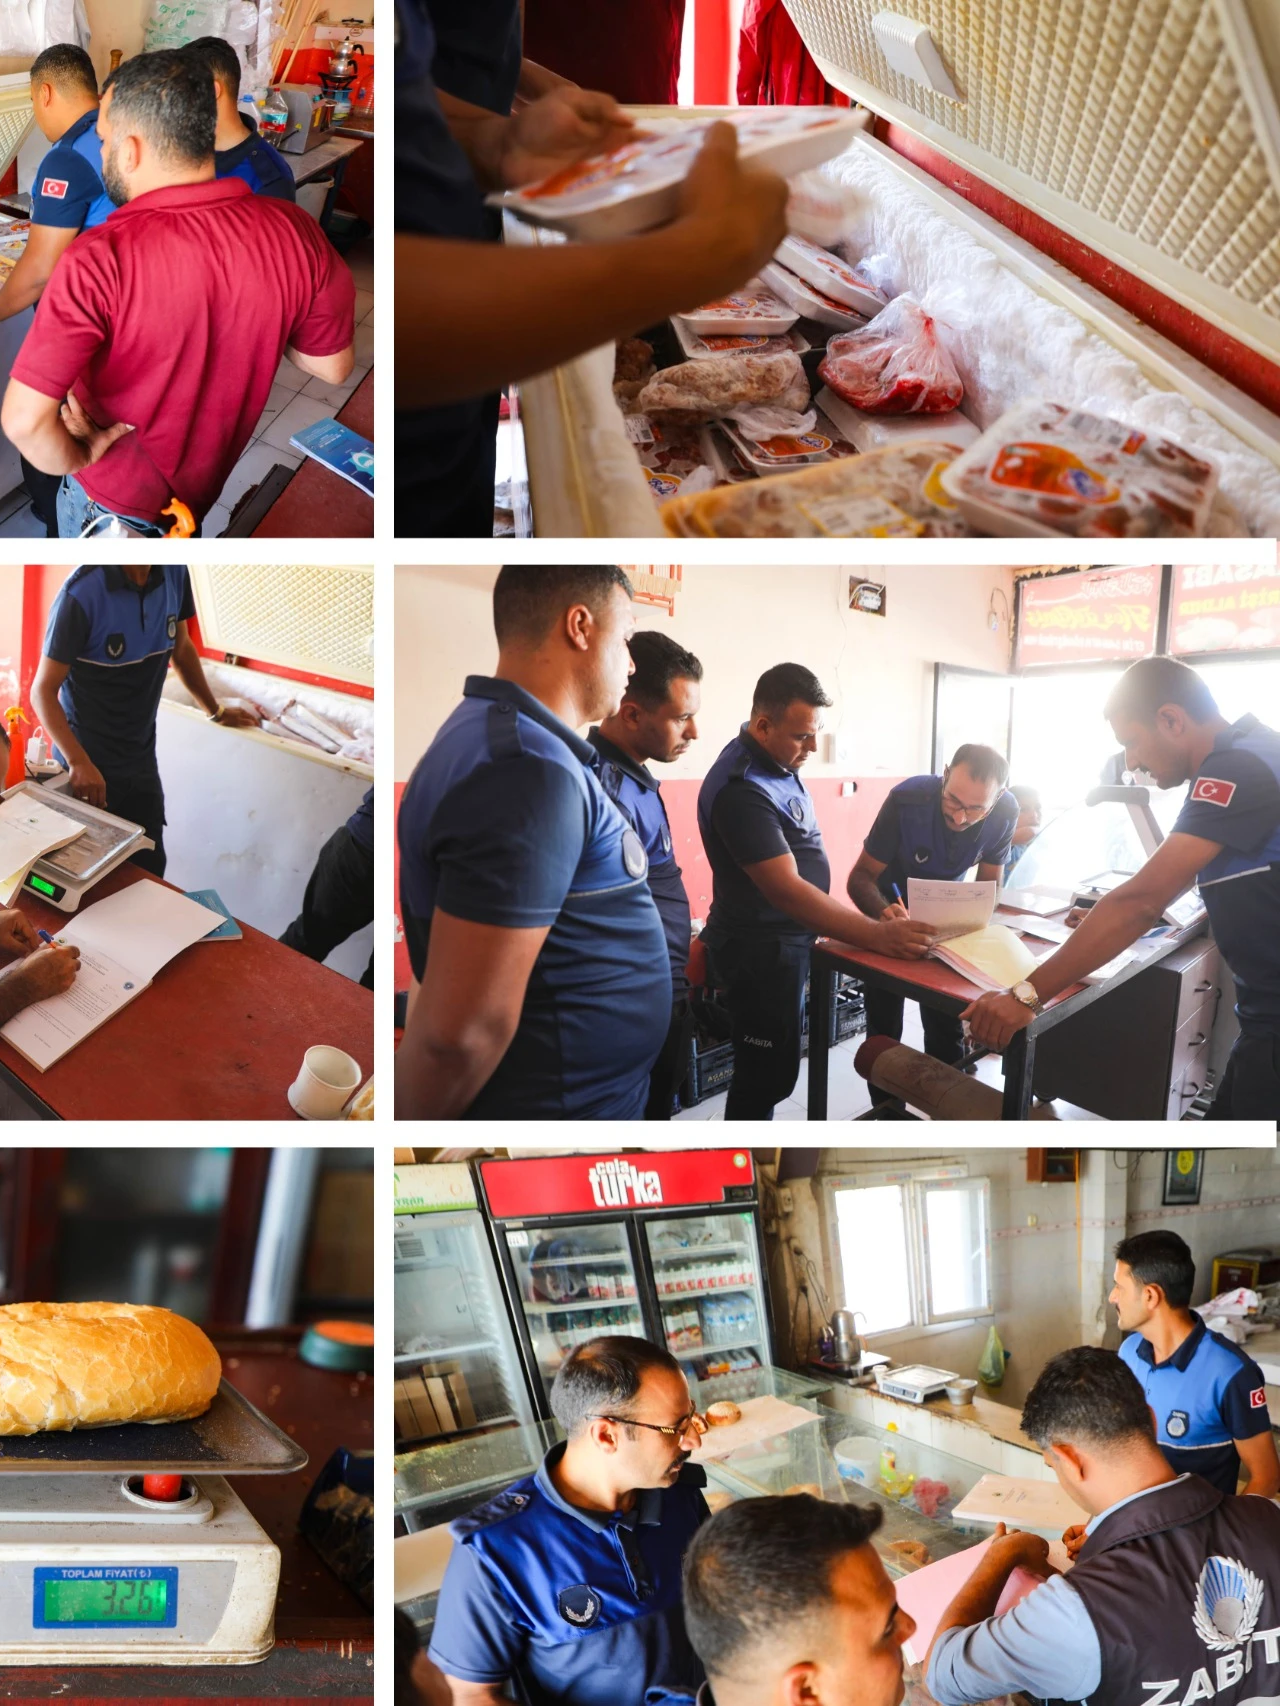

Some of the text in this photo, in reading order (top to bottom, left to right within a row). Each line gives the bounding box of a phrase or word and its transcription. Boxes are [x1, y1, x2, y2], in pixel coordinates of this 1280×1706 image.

[743, 1034, 773, 1048] ZABITA
[595, 1158, 631, 1175] cola
[62, 1569, 102, 1578] TOPLAM
